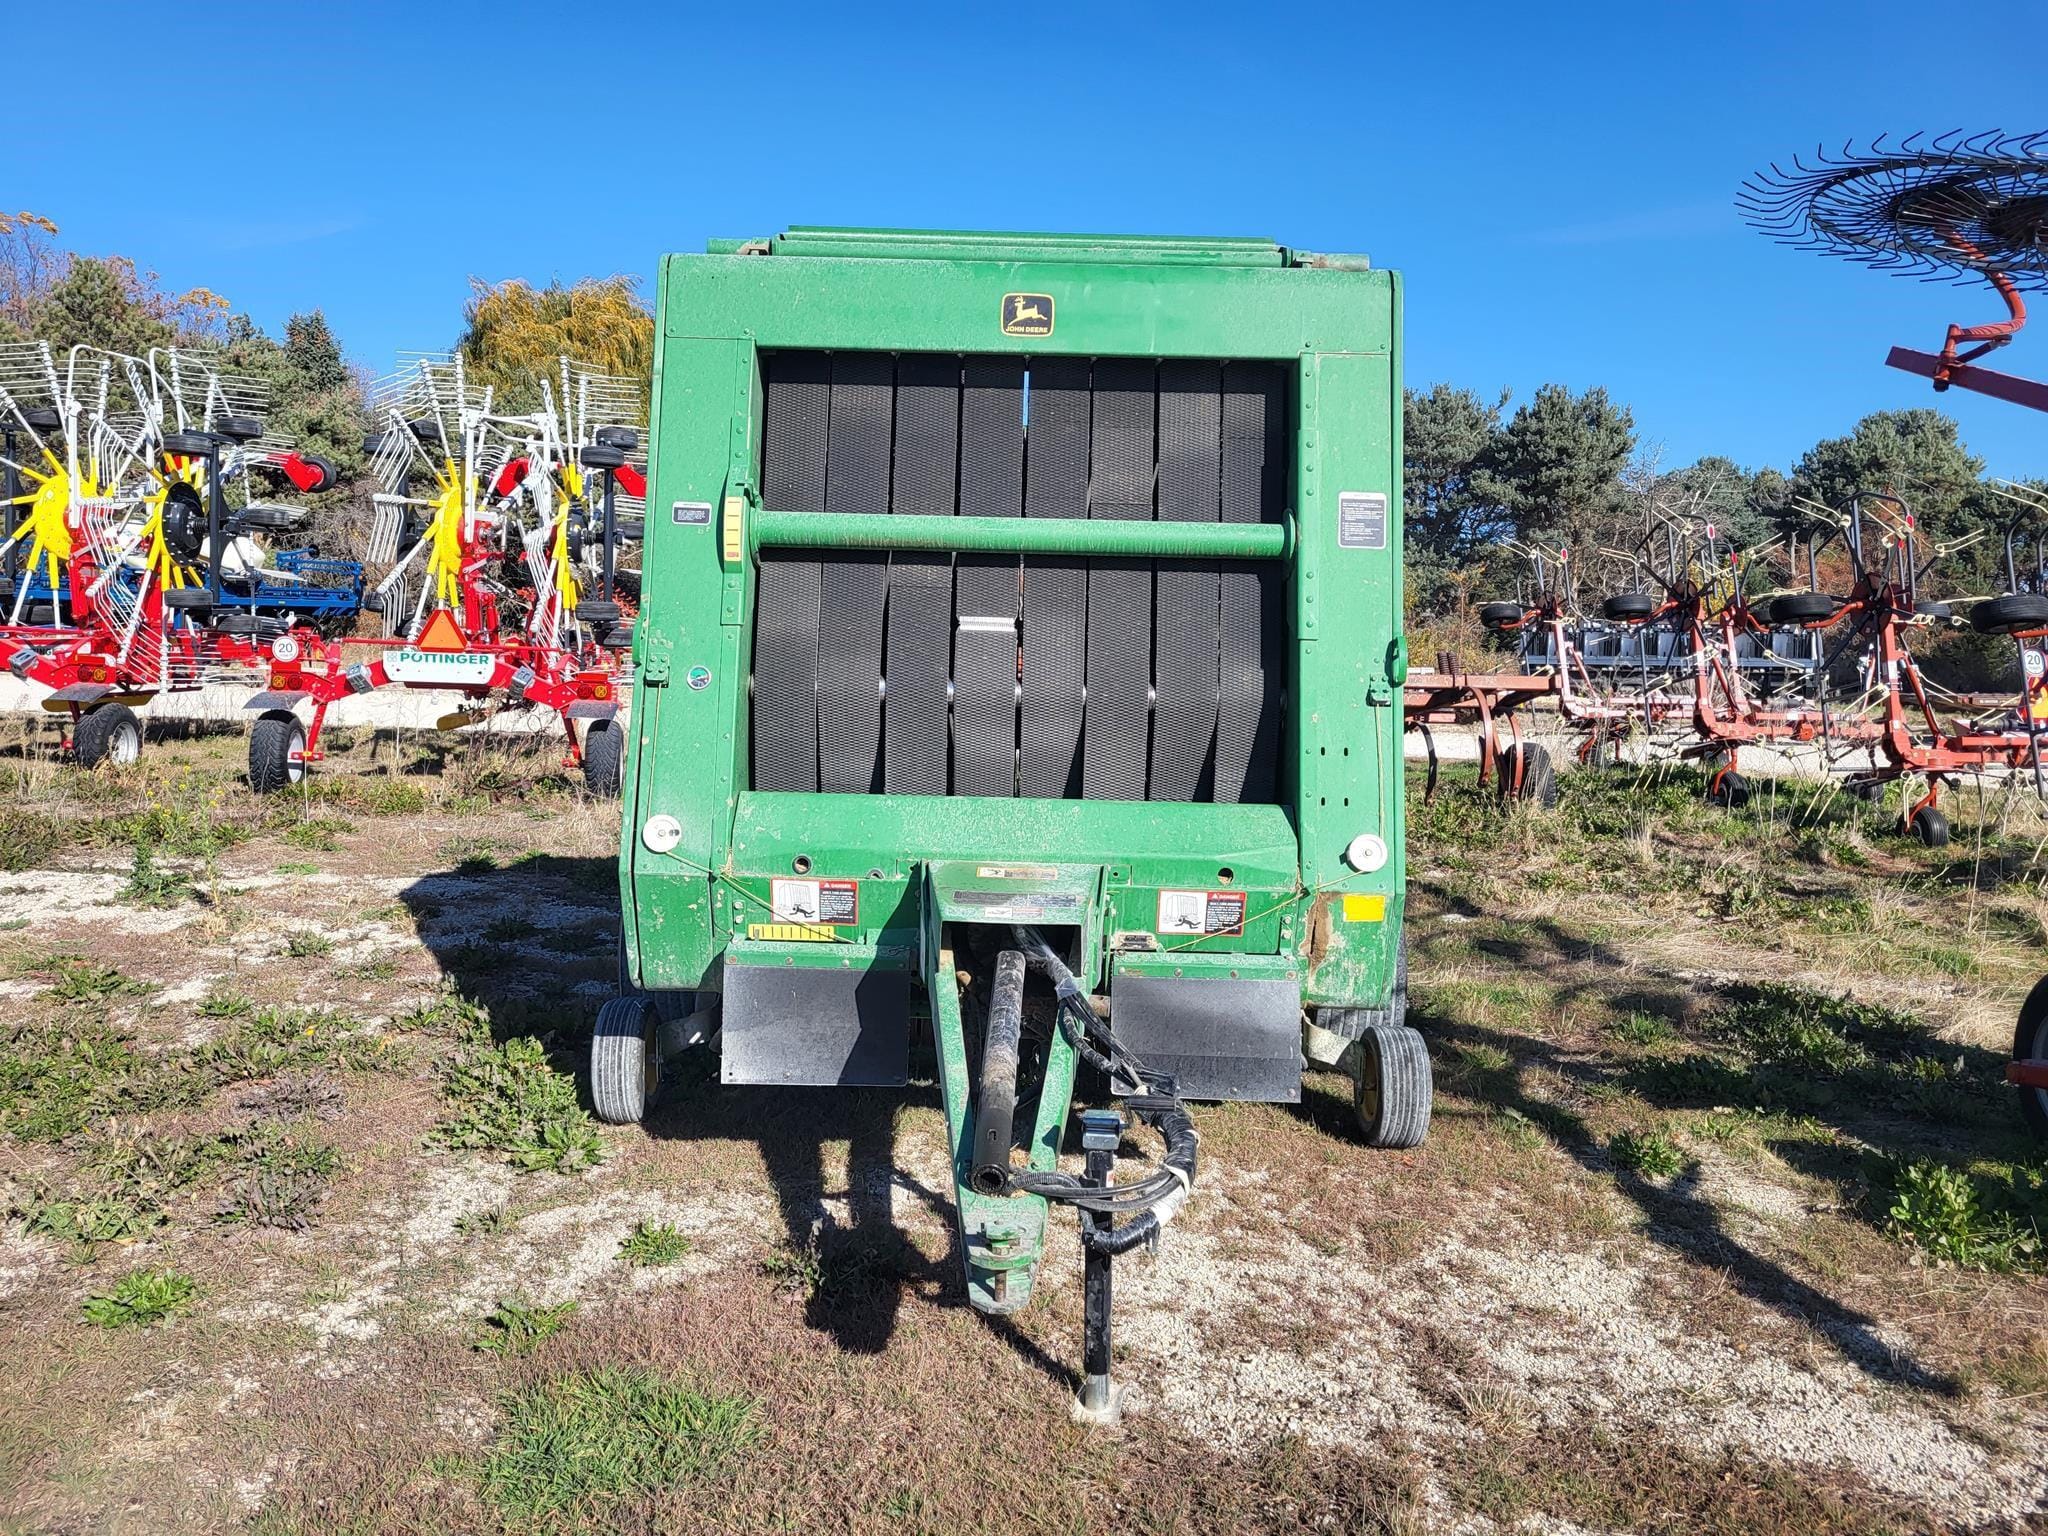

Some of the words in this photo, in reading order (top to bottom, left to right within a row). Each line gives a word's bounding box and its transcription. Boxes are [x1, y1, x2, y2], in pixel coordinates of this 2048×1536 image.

[1006, 325, 1024, 333] JOHN
[279, 643, 293, 653] 20
[2027, 654, 2041, 665] 20
